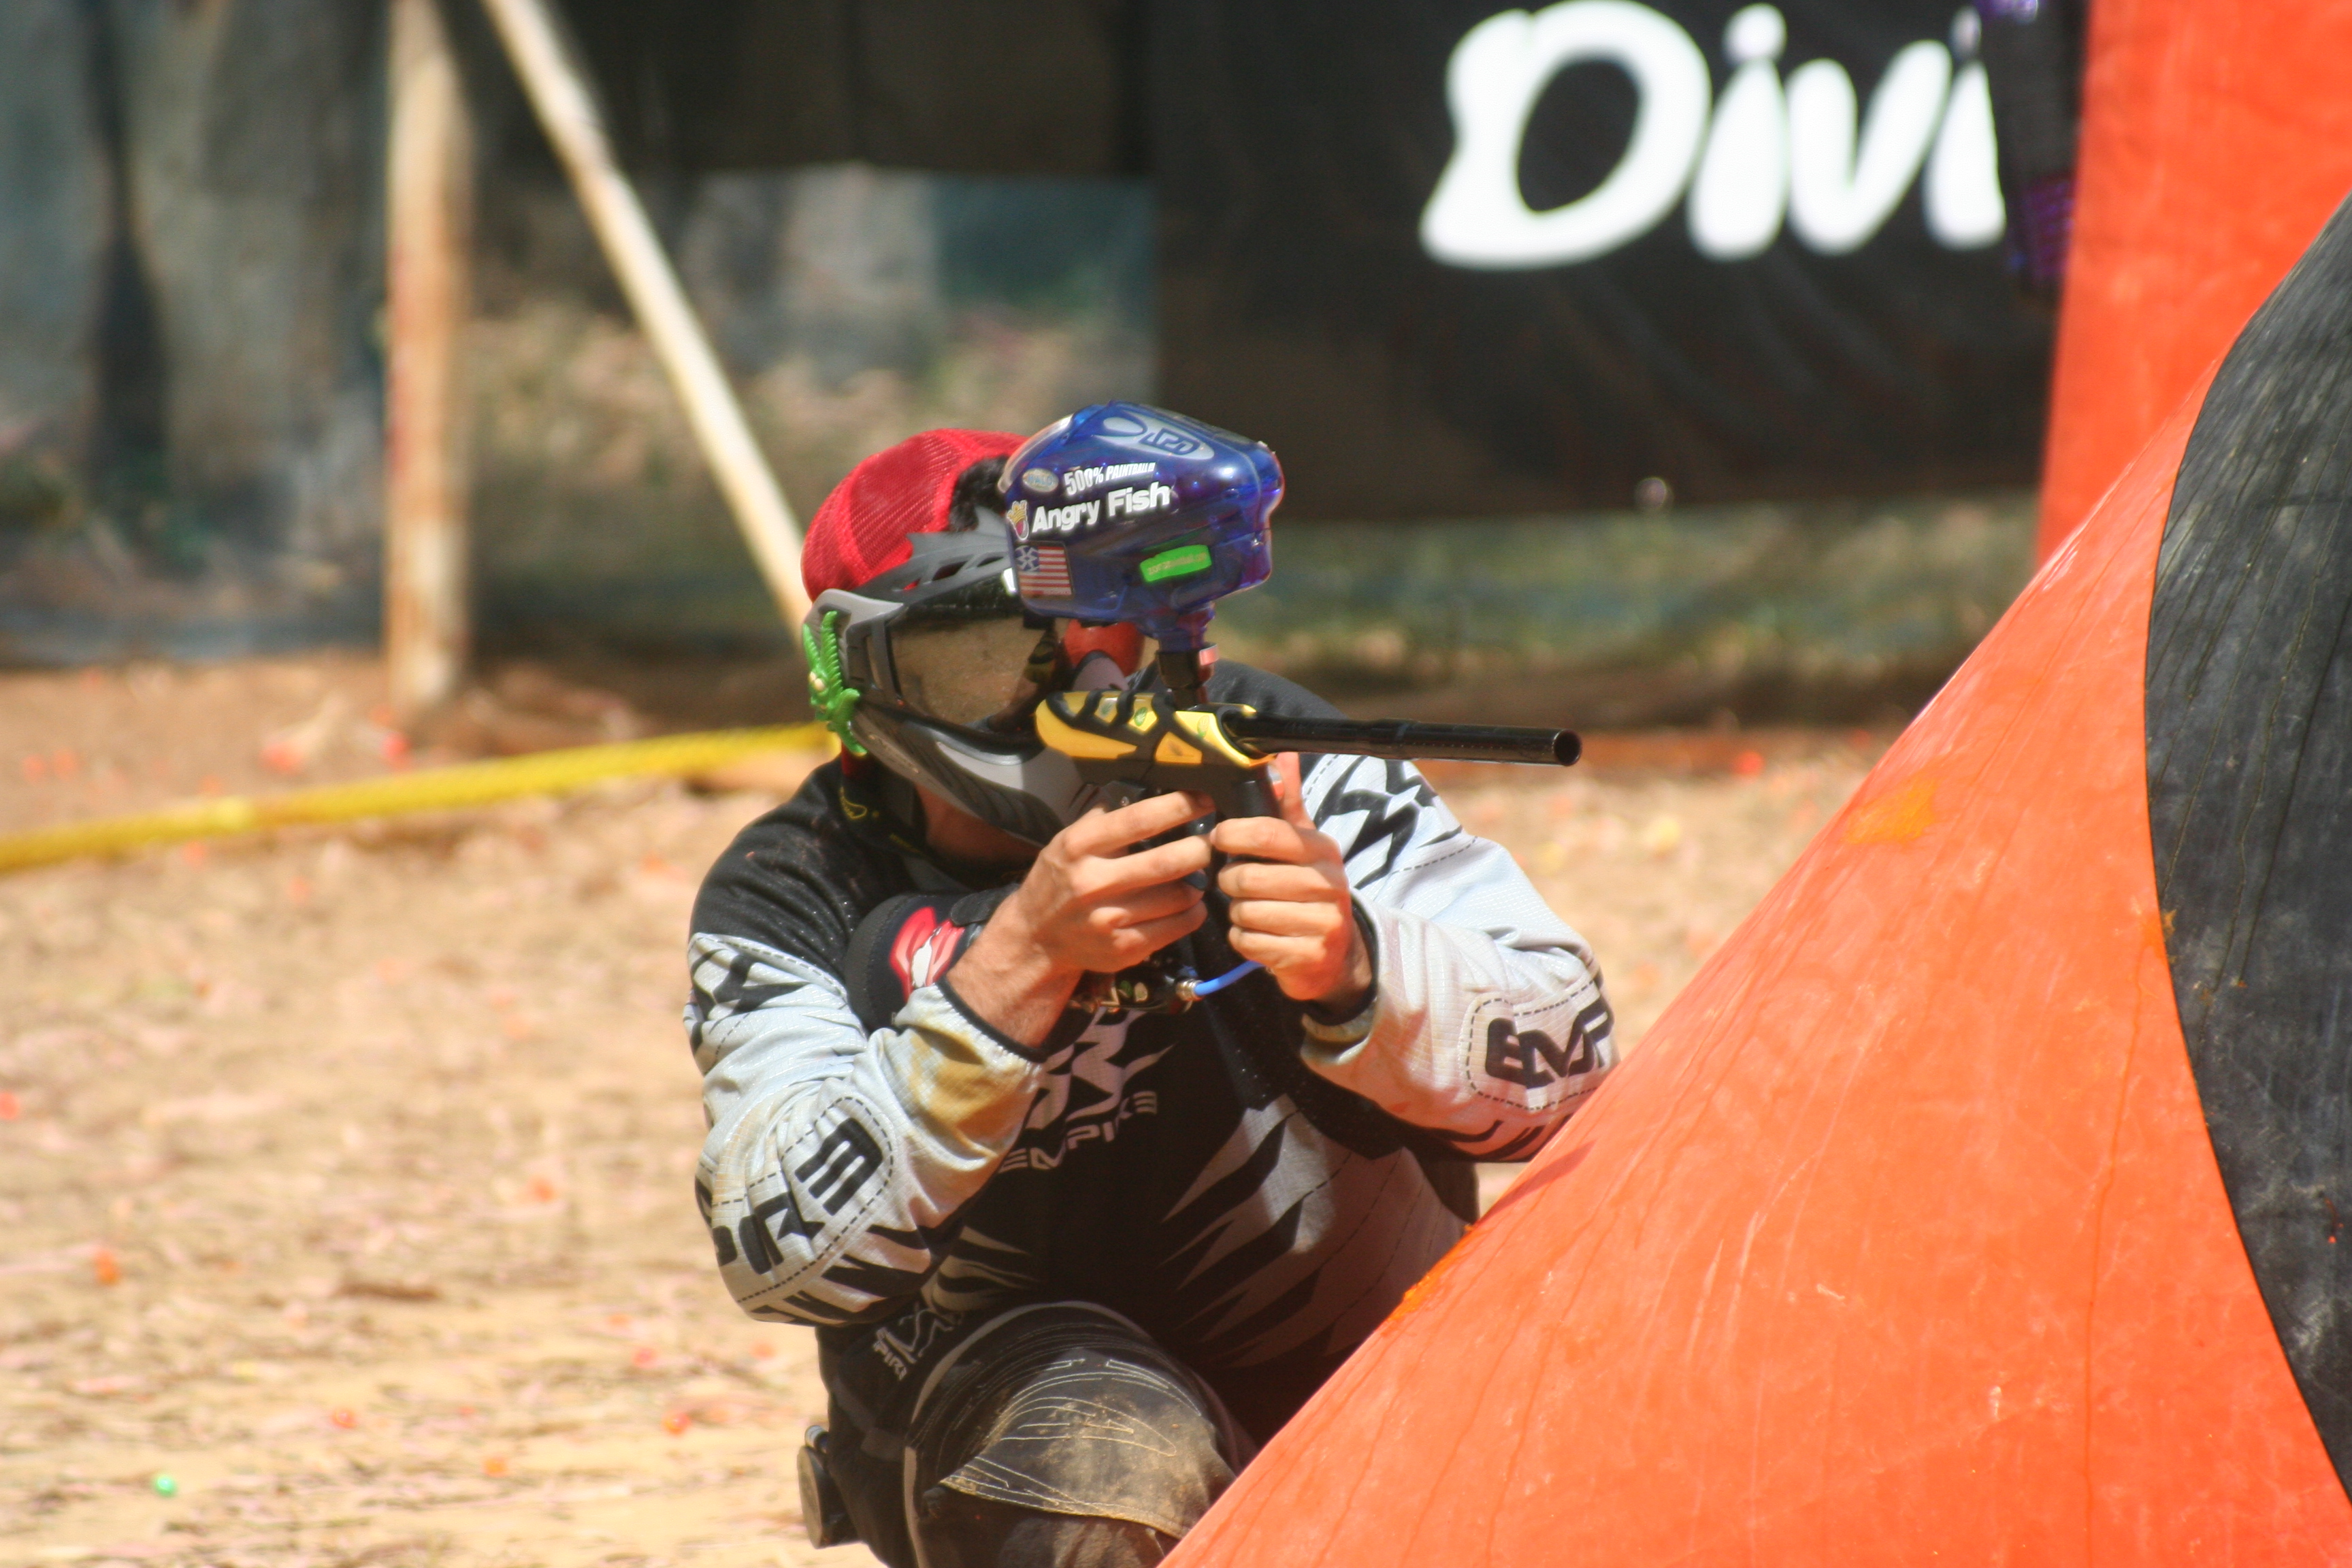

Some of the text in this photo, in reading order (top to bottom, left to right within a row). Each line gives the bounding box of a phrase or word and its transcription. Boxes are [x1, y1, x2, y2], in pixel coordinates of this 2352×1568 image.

[1064, 466, 1105, 496] 500%
[1105, 462, 1149, 481] PAINTBALL
[1031, 481, 1171, 534] Angry Fish
